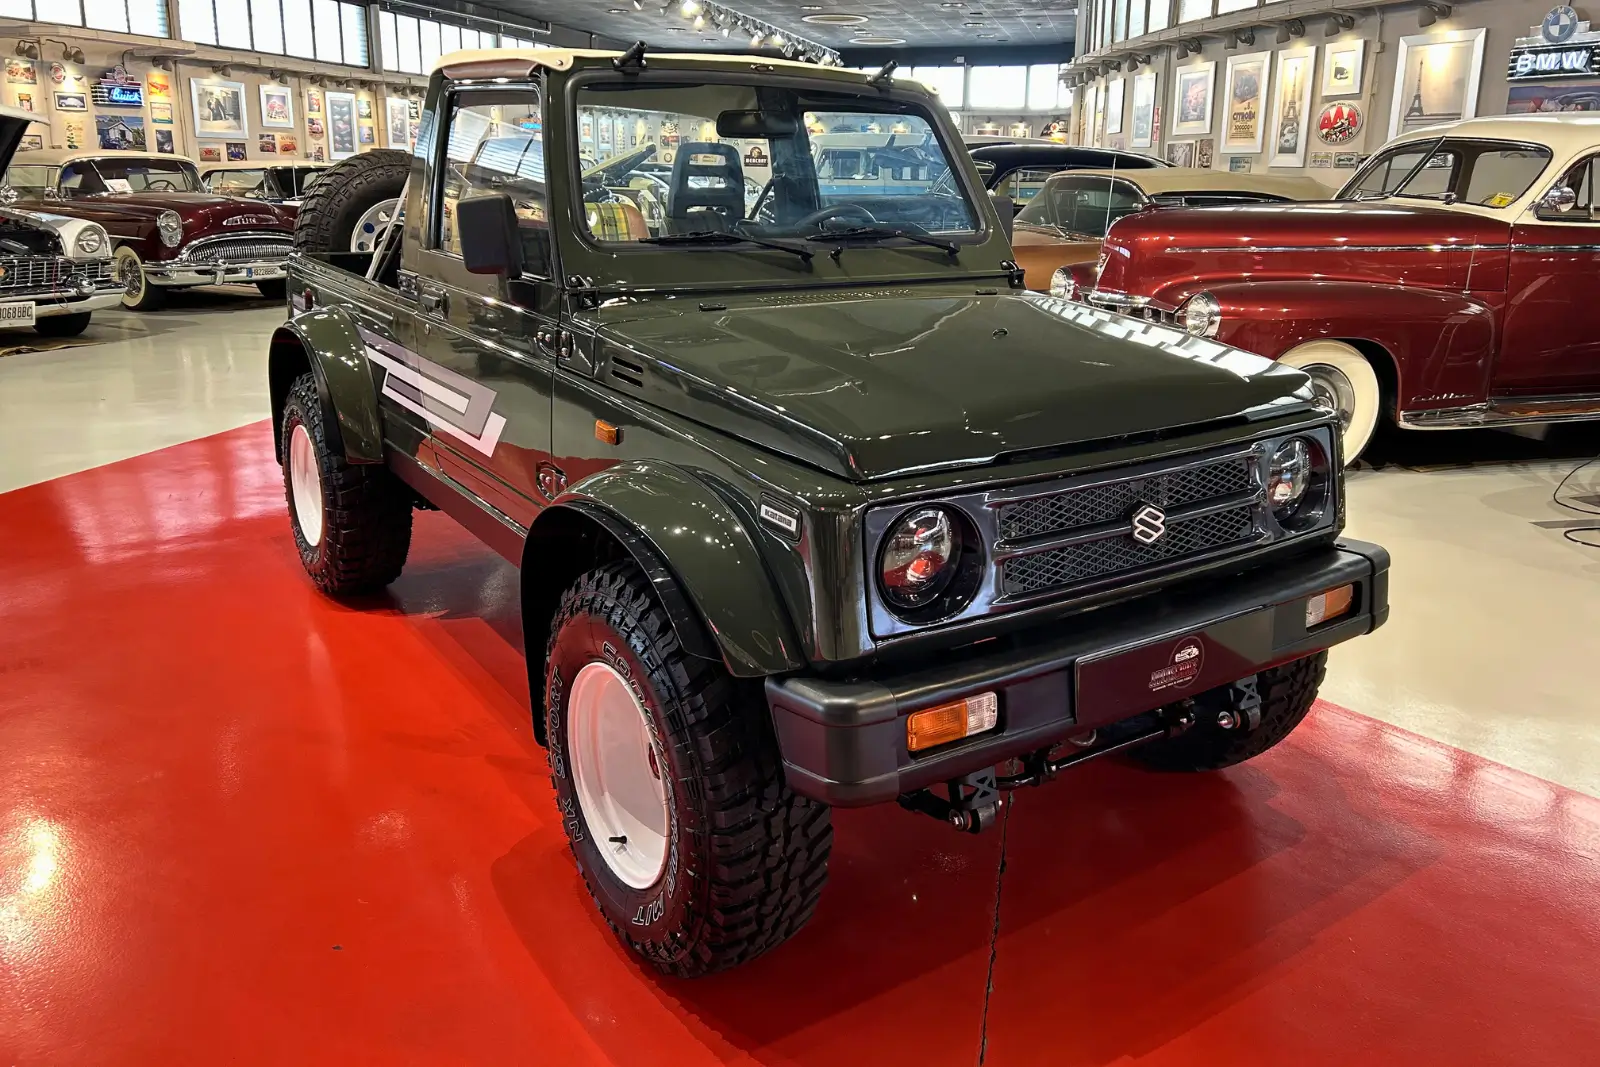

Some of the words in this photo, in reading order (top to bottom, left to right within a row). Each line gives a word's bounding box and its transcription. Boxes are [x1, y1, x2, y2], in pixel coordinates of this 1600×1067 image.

[1547, 7, 1575, 20] BMW
[1516, 49, 1589, 73] BMW
[112, 86, 140, 101] Buick
[1320, 106, 1357, 130] AAA
[550, 665, 566, 779] SPORT
